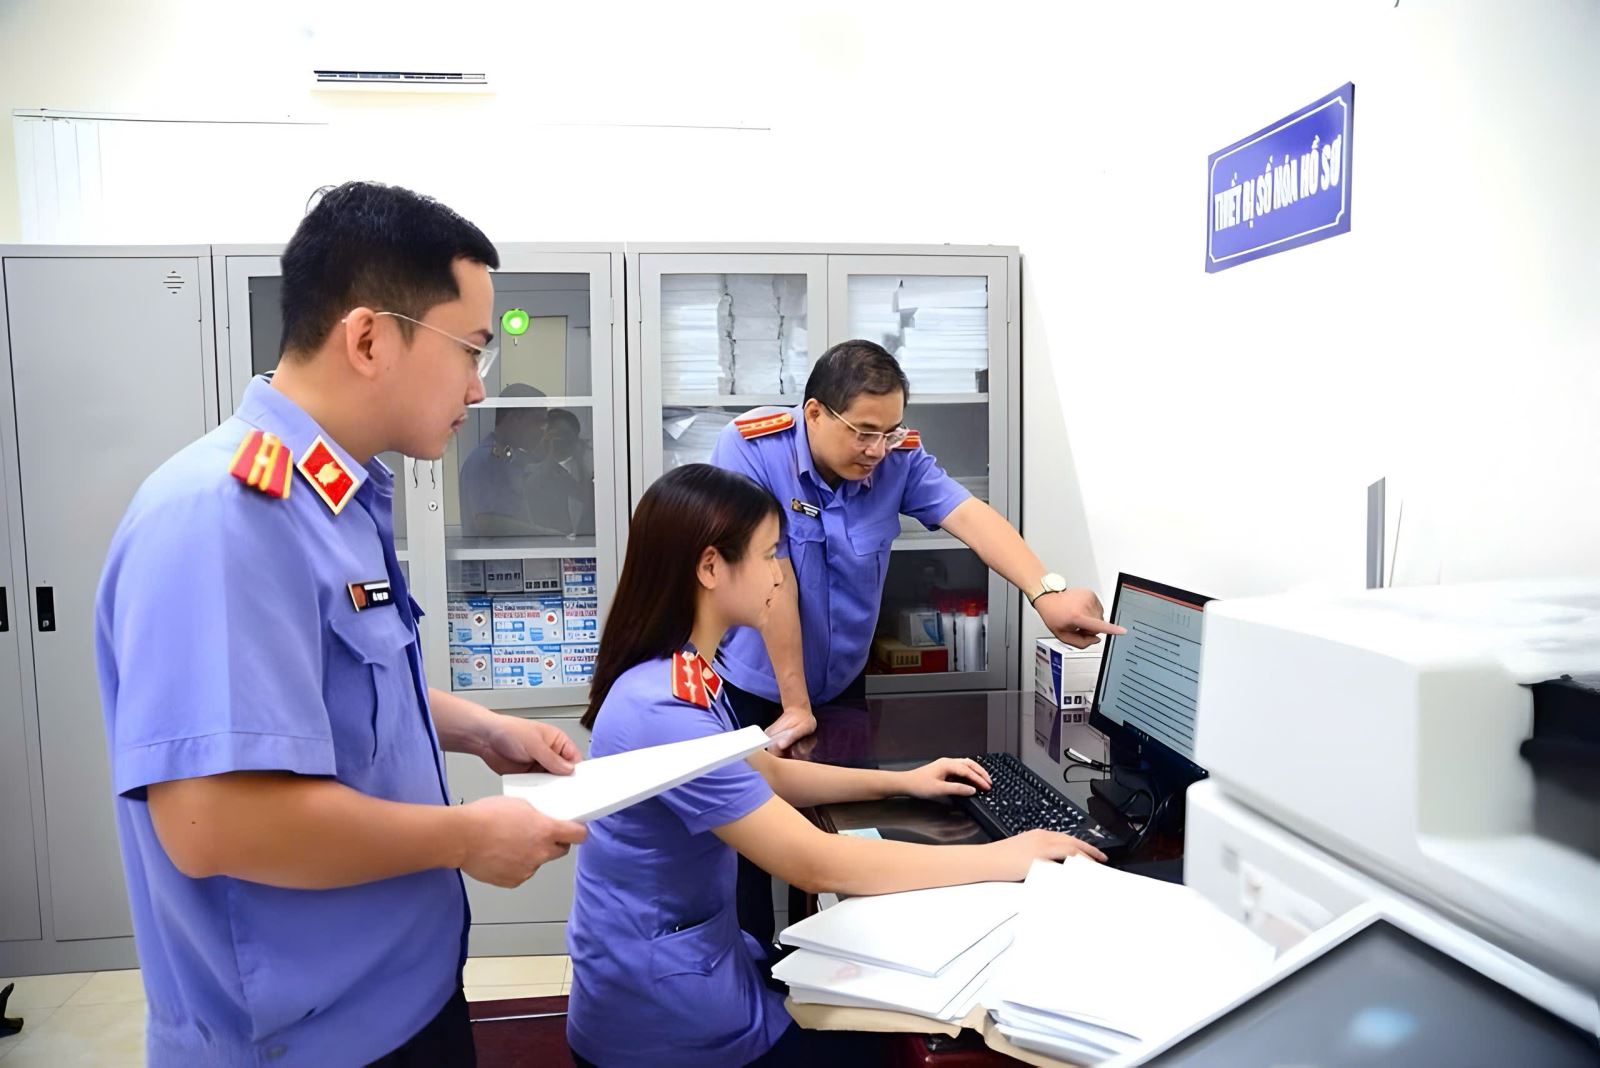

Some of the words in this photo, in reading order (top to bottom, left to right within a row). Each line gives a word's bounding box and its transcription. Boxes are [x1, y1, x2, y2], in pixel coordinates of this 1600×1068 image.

[1243, 179, 1255, 228] BỊ
[1256, 155, 1273, 216] SỐ
[1321, 134, 1342, 190] SƠ
